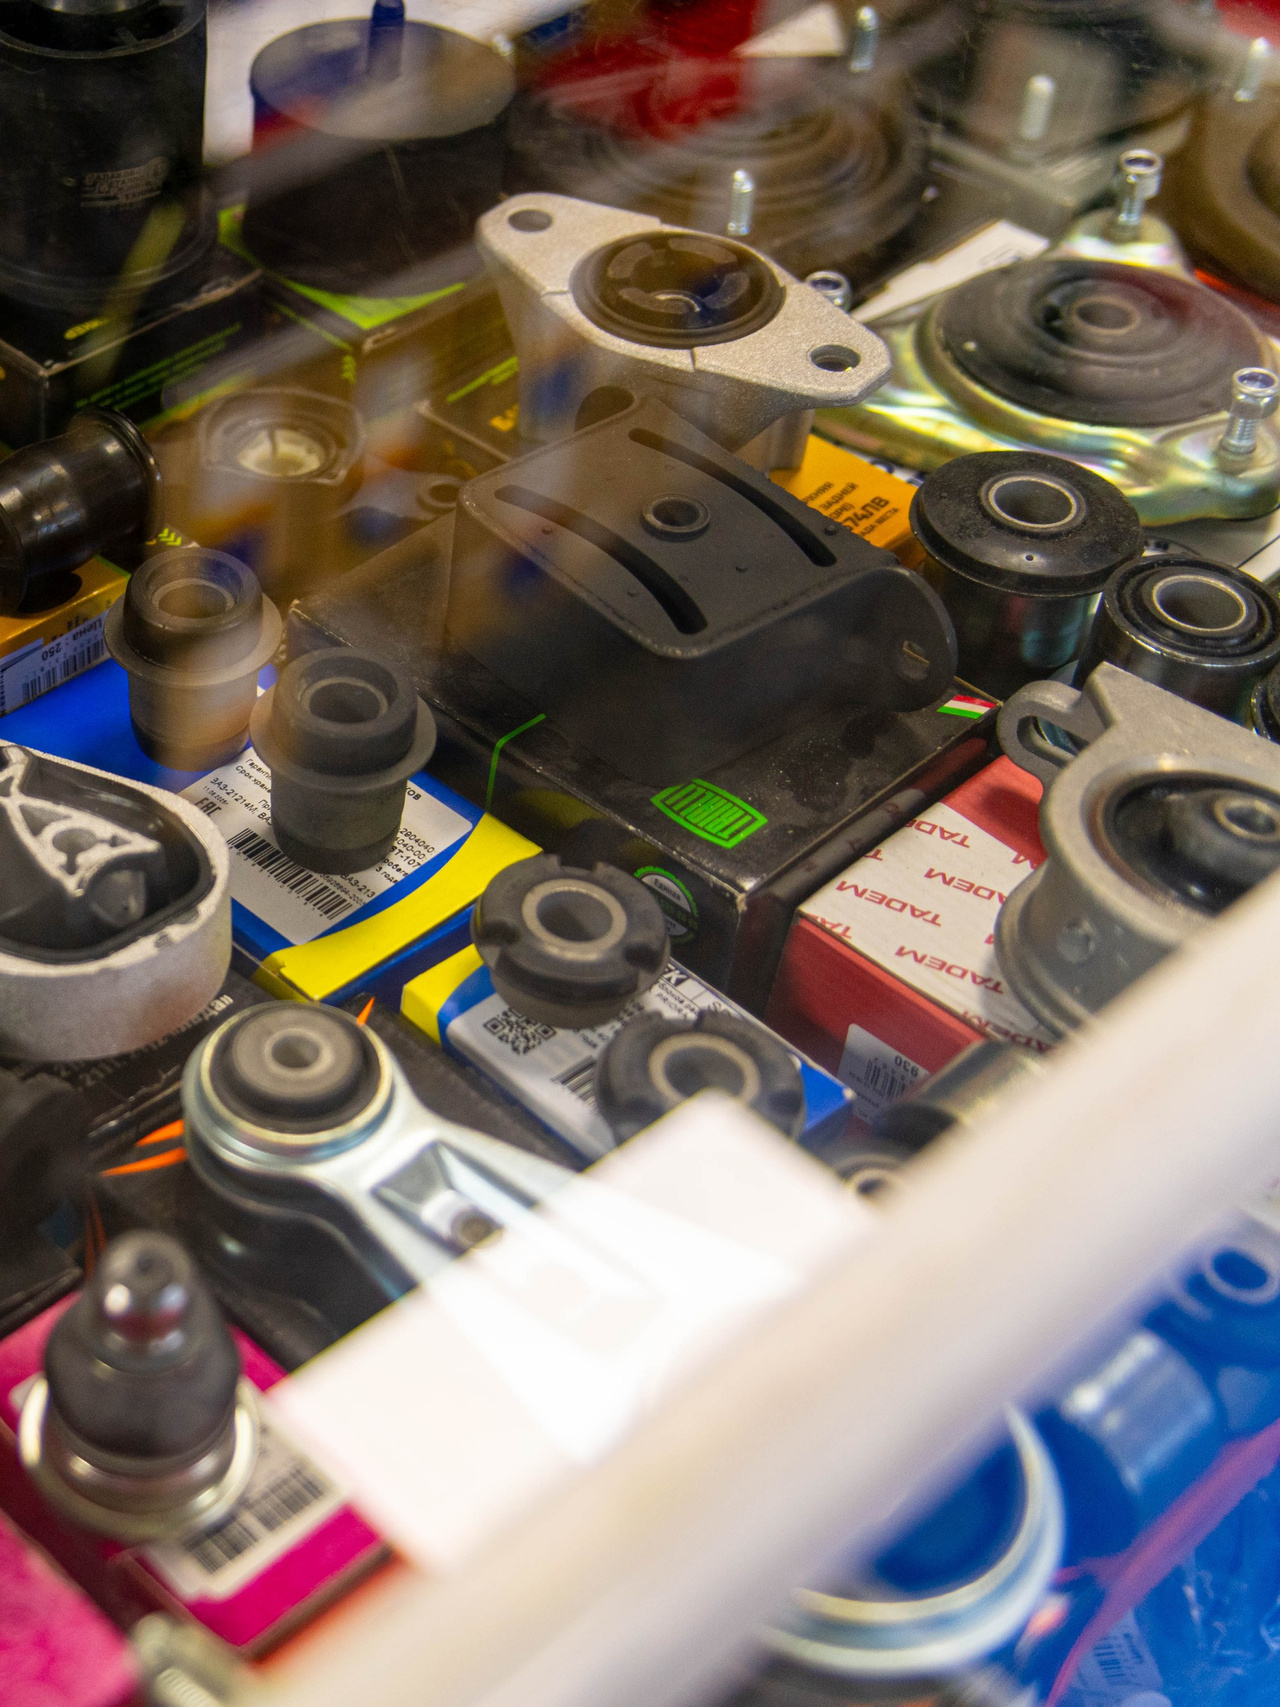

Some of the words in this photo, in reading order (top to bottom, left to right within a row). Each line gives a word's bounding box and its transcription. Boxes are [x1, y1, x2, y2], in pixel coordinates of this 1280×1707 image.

[843, 496, 890, 532] 74ЛВ
[40, 642, 63, 662] 250
[245, 758, 271, 780] Гаранти
[382, 858, 409, 877] робега
[399, 827, 437, 855] 2904040;
[835, 880, 943, 928] TADEM
[894, 945, 1005, 996] TADEM
[894, 1053, 919, 1078] 930
